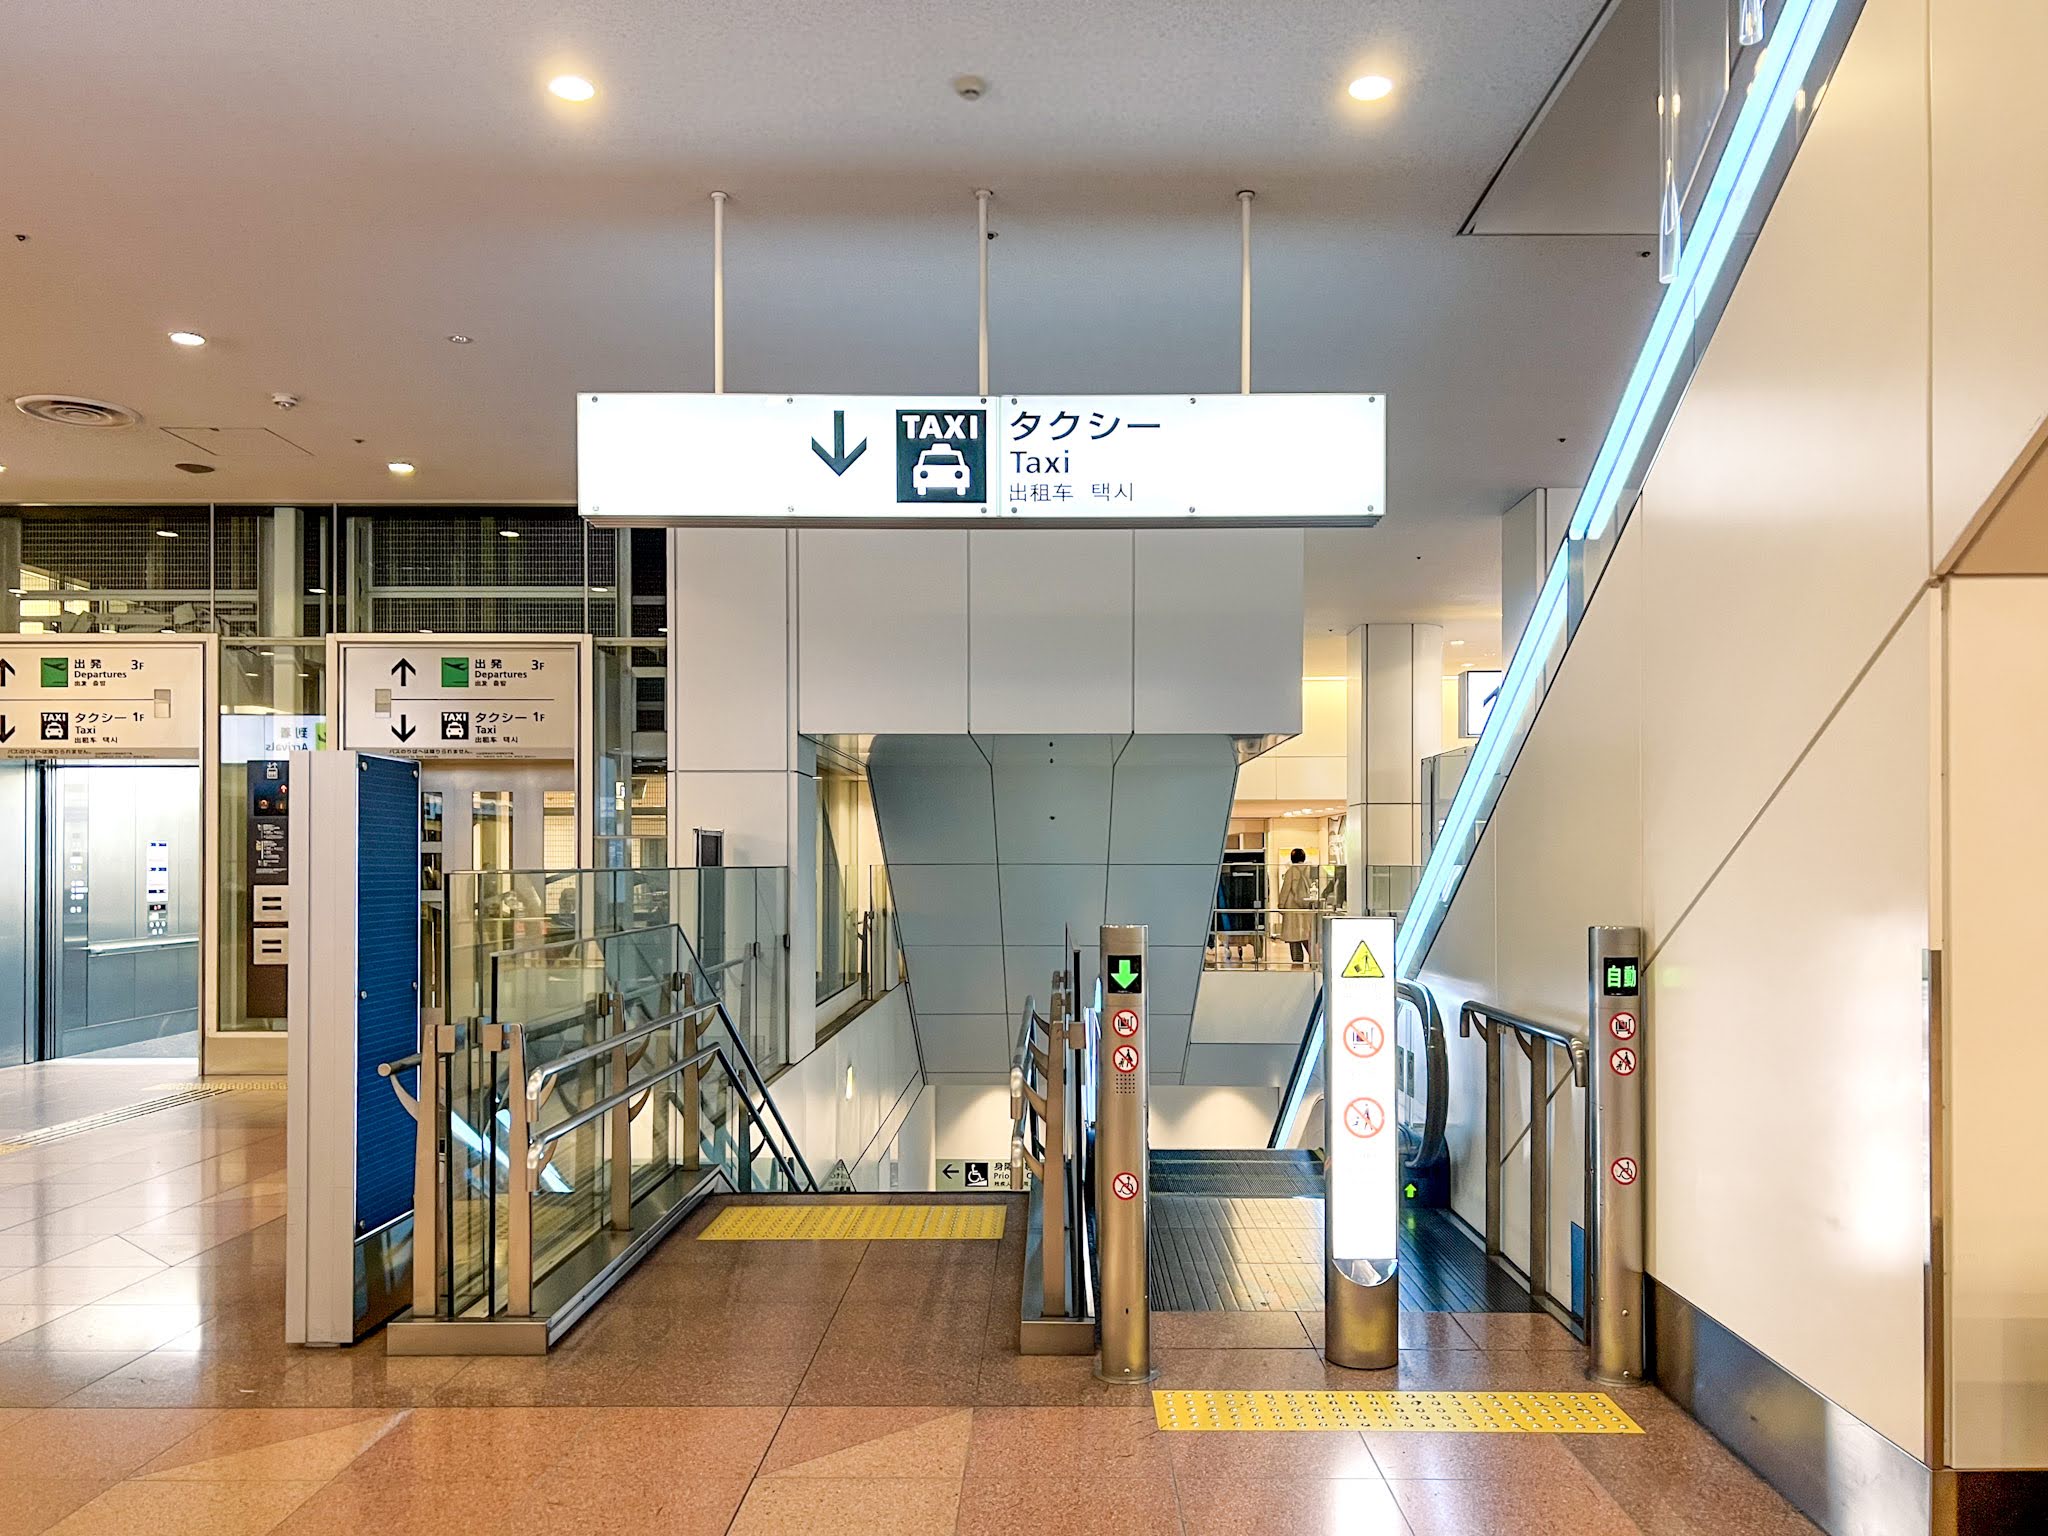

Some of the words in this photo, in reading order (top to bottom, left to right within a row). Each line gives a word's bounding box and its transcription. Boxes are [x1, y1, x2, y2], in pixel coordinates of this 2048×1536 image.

[902, 414, 978, 439] TAXI
[1010, 411, 1160, 441] タクシー
[1010, 450, 1069, 473] Taxi
[1010, 483, 1073, 502] 出租车
[1092, 482, 1132, 501] 택시
[131, 659, 144, 670] 3F
[531, 659, 545, 670] 3F
[74, 671, 127, 679] Departures
[475, 671, 528, 680] Departures
[42, 713, 66, 721] TAXI
[75, 712, 127, 723] タクシー
[132, 711, 144, 721] 1F
[443, 713, 467, 721] TAXI
[475, 712, 527, 723] タクシー
[533, 711, 545, 721] 1F
[75, 725, 96, 734] Taxi
[475, 725, 497, 734] Taxi
[1608, 965, 1636, 987] 自動
